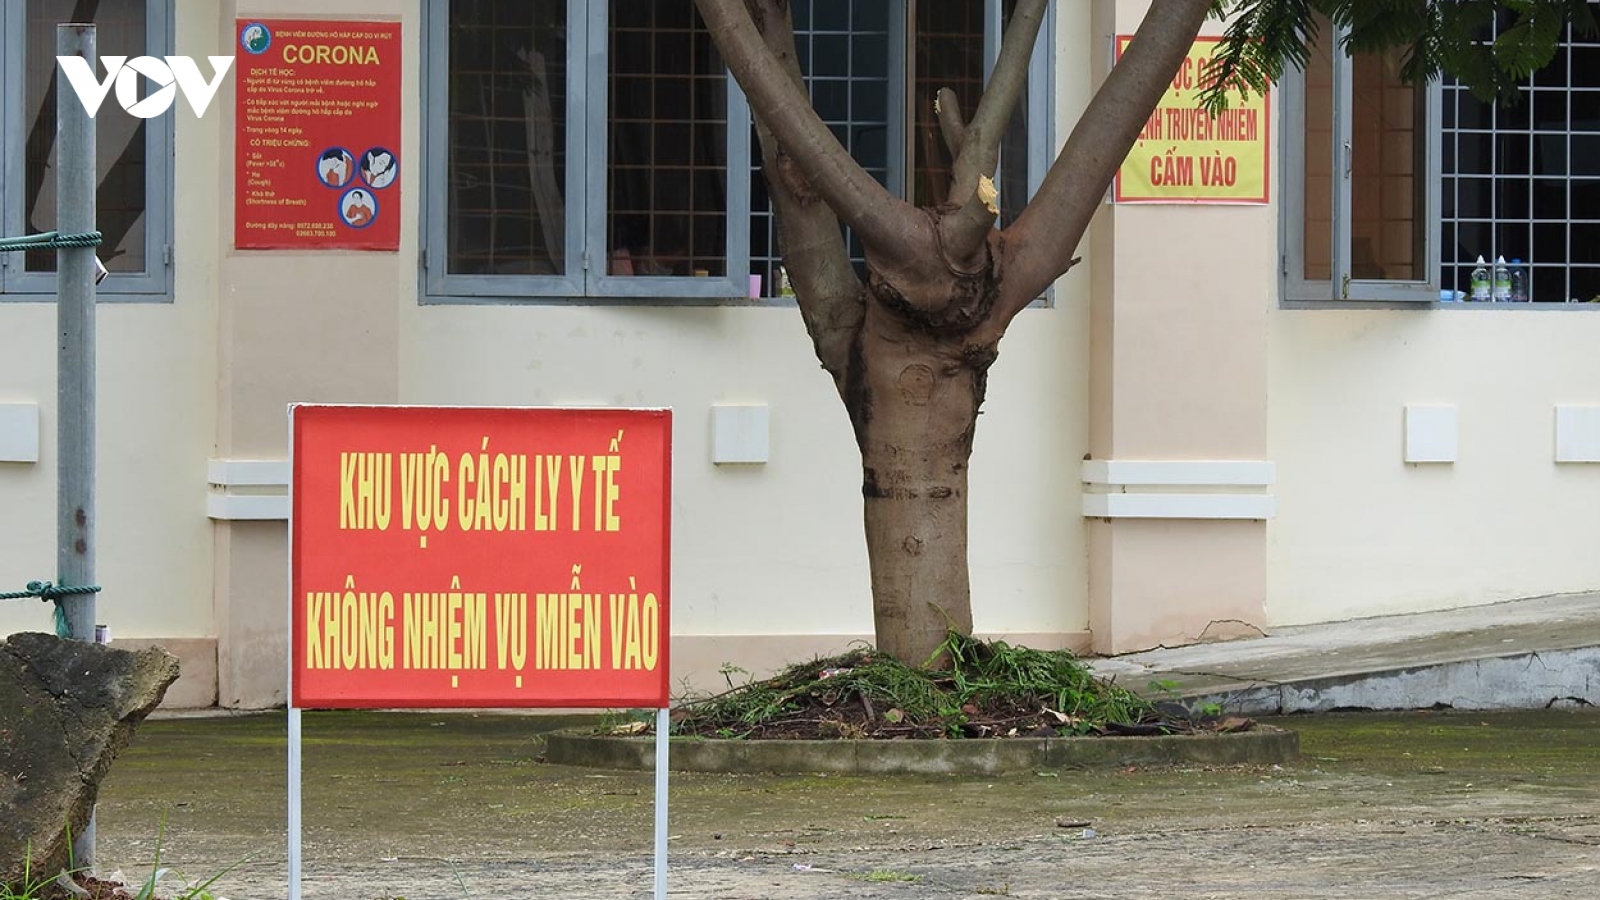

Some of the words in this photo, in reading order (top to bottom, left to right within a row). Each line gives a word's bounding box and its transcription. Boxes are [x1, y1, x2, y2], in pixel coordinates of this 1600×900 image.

[283, 44, 380, 65] CORONA
[250, 68, 267, 76] DỊCH
[284, 86, 305, 94] Corona
[263, 115, 285, 123] Corona
[1150, 145, 1194, 187] CẤM
[1199, 149, 1236, 187] VÀO
[247, 178, 272, 187] (Cough)
[278, 198, 285, 206] of
[340, 451, 392, 531] KHU
[399, 444, 449, 549] VỰC
[457, 436, 527, 532] CÁCH
[534, 454, 563, 531] LY
[569, 455, 586, 531] Y
[592, 429, 625, 532] TẾ
[306, 574, 395, 670] KHÔNG
[403, 574, 487, 689] NHIỆM
[494, 592, 528, 689] VỤ
[535, 563, 601, 671] MIỄN
[609, 575, 659, 671] VÀO
